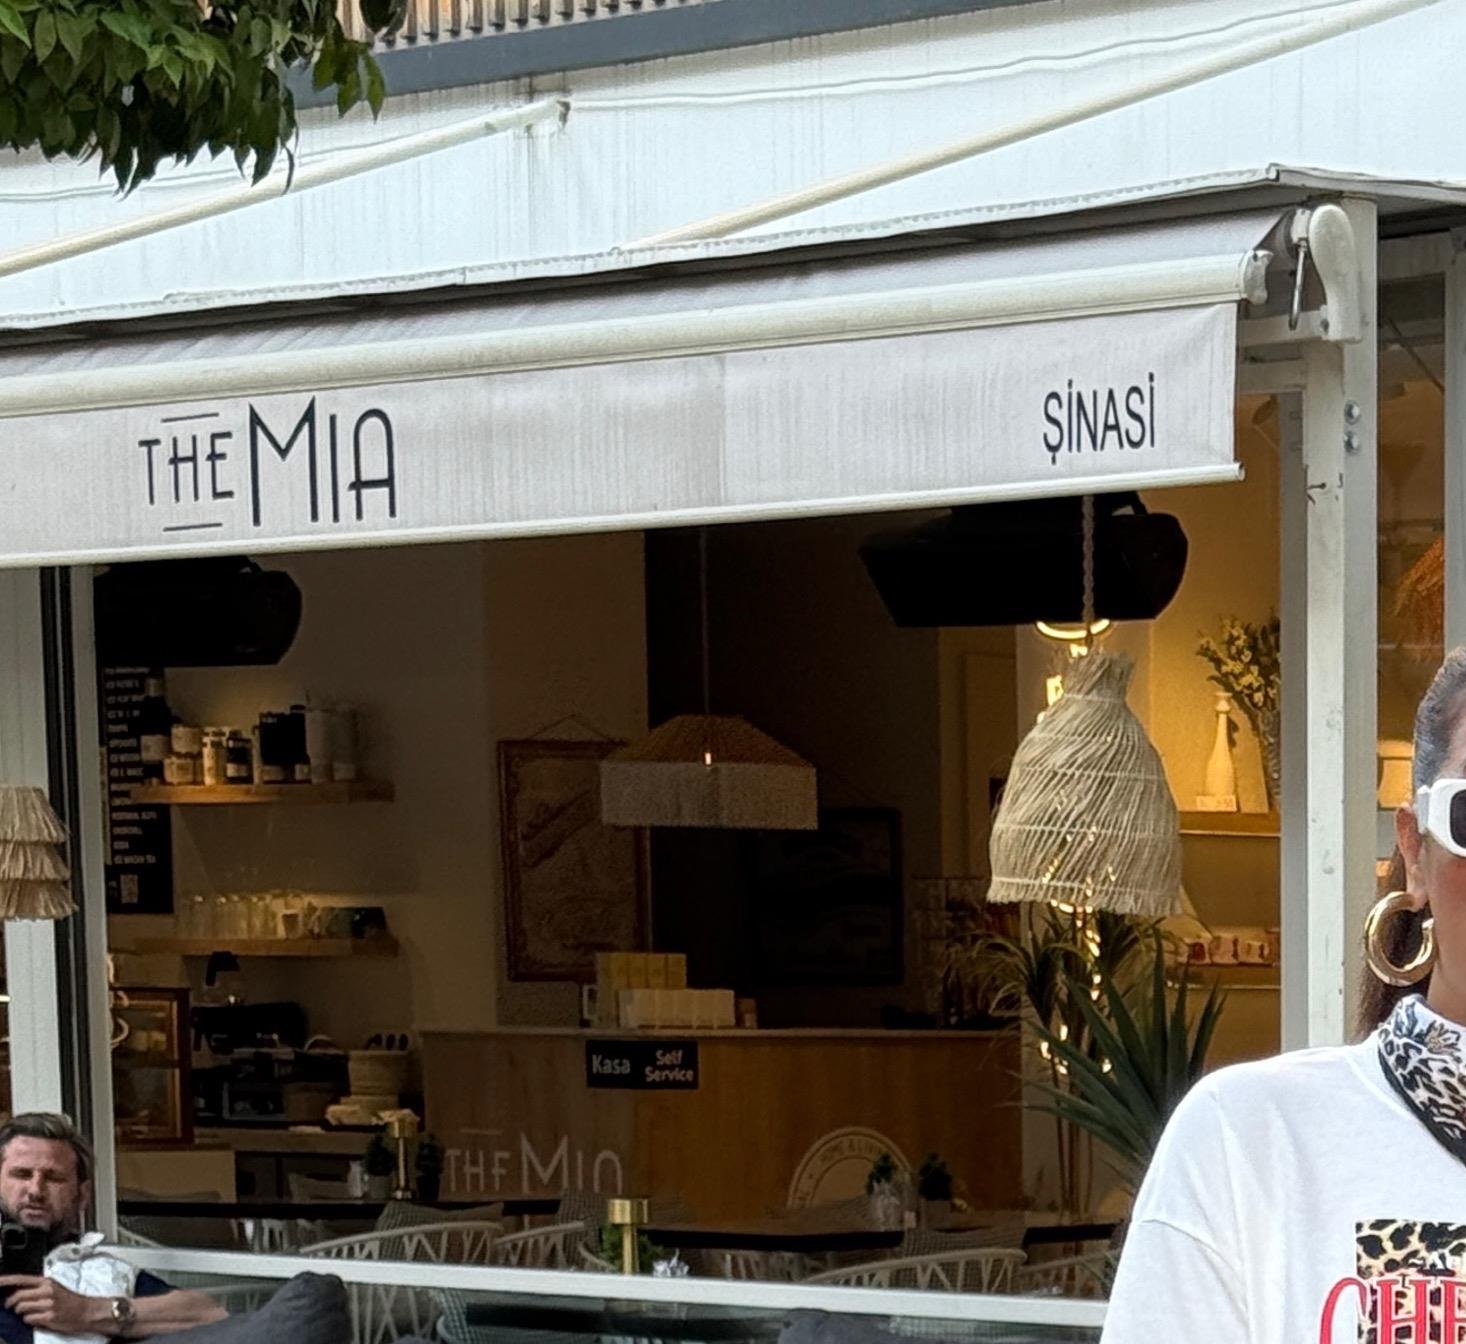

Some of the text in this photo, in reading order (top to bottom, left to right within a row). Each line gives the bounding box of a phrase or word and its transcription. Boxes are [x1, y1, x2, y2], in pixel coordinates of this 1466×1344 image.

[1042, 371, 1156, 464] ŞİNASİ
[591, 1053, 632, 1075] Kasa
[654, 1048, 684, 1066] Self
[643, 1064, 695, 1083] Service
